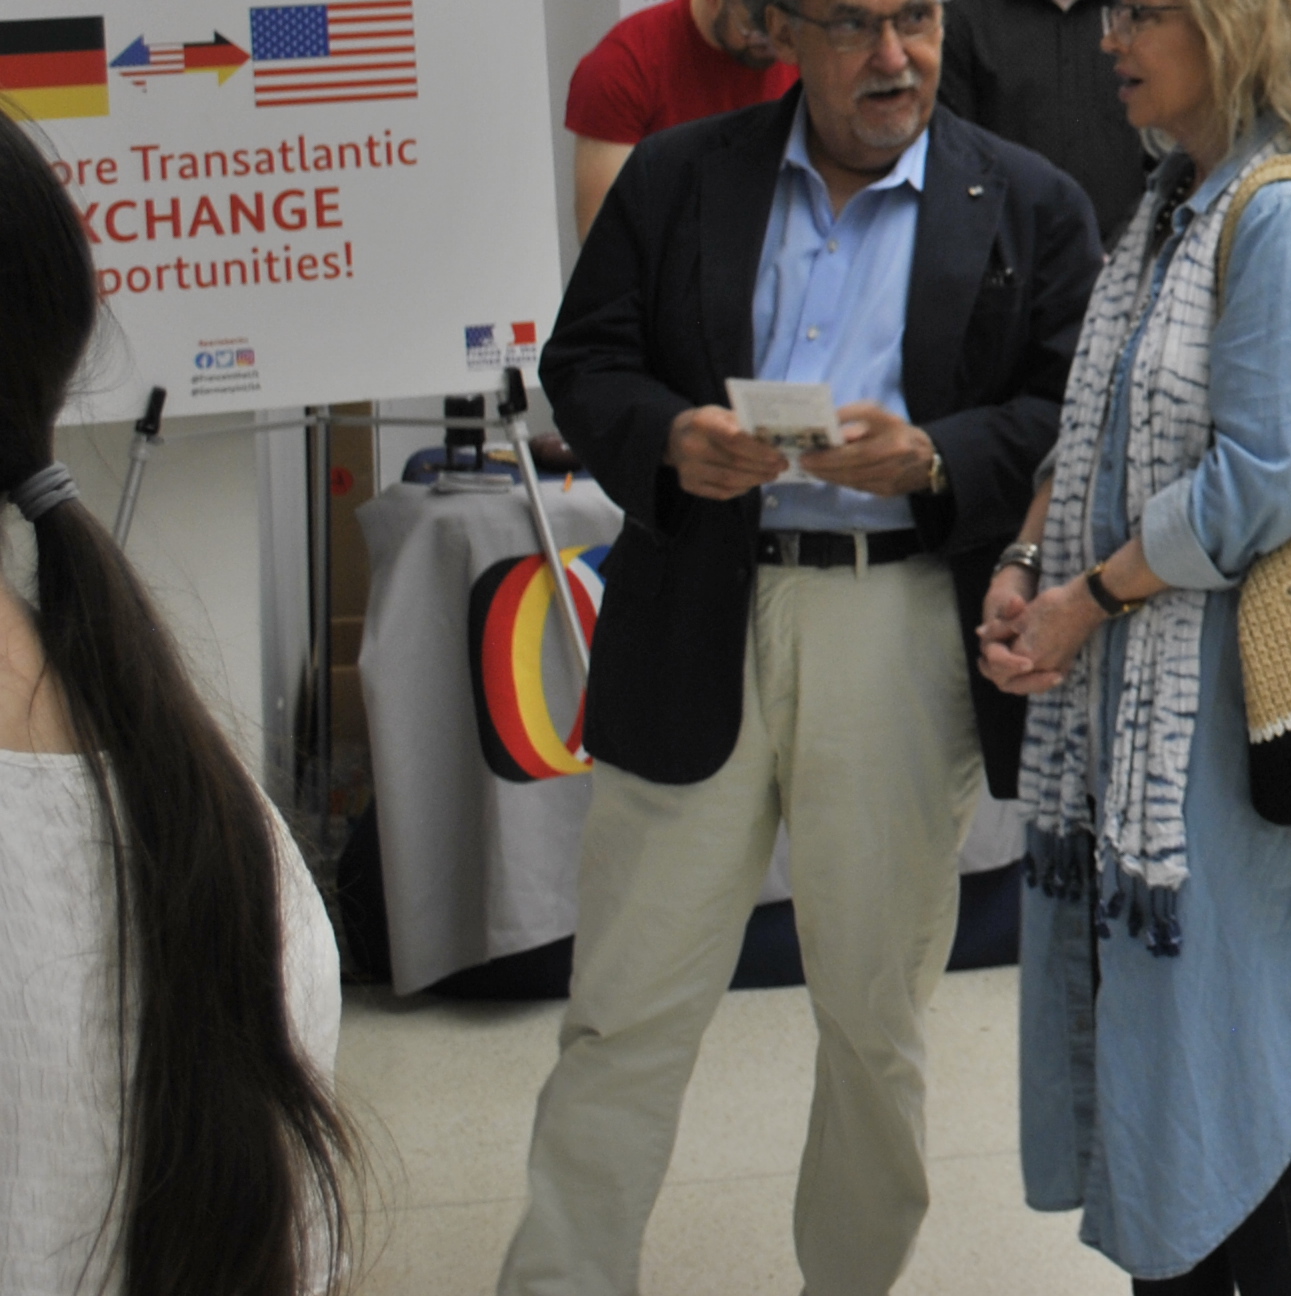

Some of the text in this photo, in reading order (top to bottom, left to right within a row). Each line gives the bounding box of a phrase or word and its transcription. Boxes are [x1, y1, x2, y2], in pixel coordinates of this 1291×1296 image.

[130, 129, 419, 183] Transatlantic
[79, 186, 344, 244] XCHANGE
[97, 241, 354, 298] portunities!
